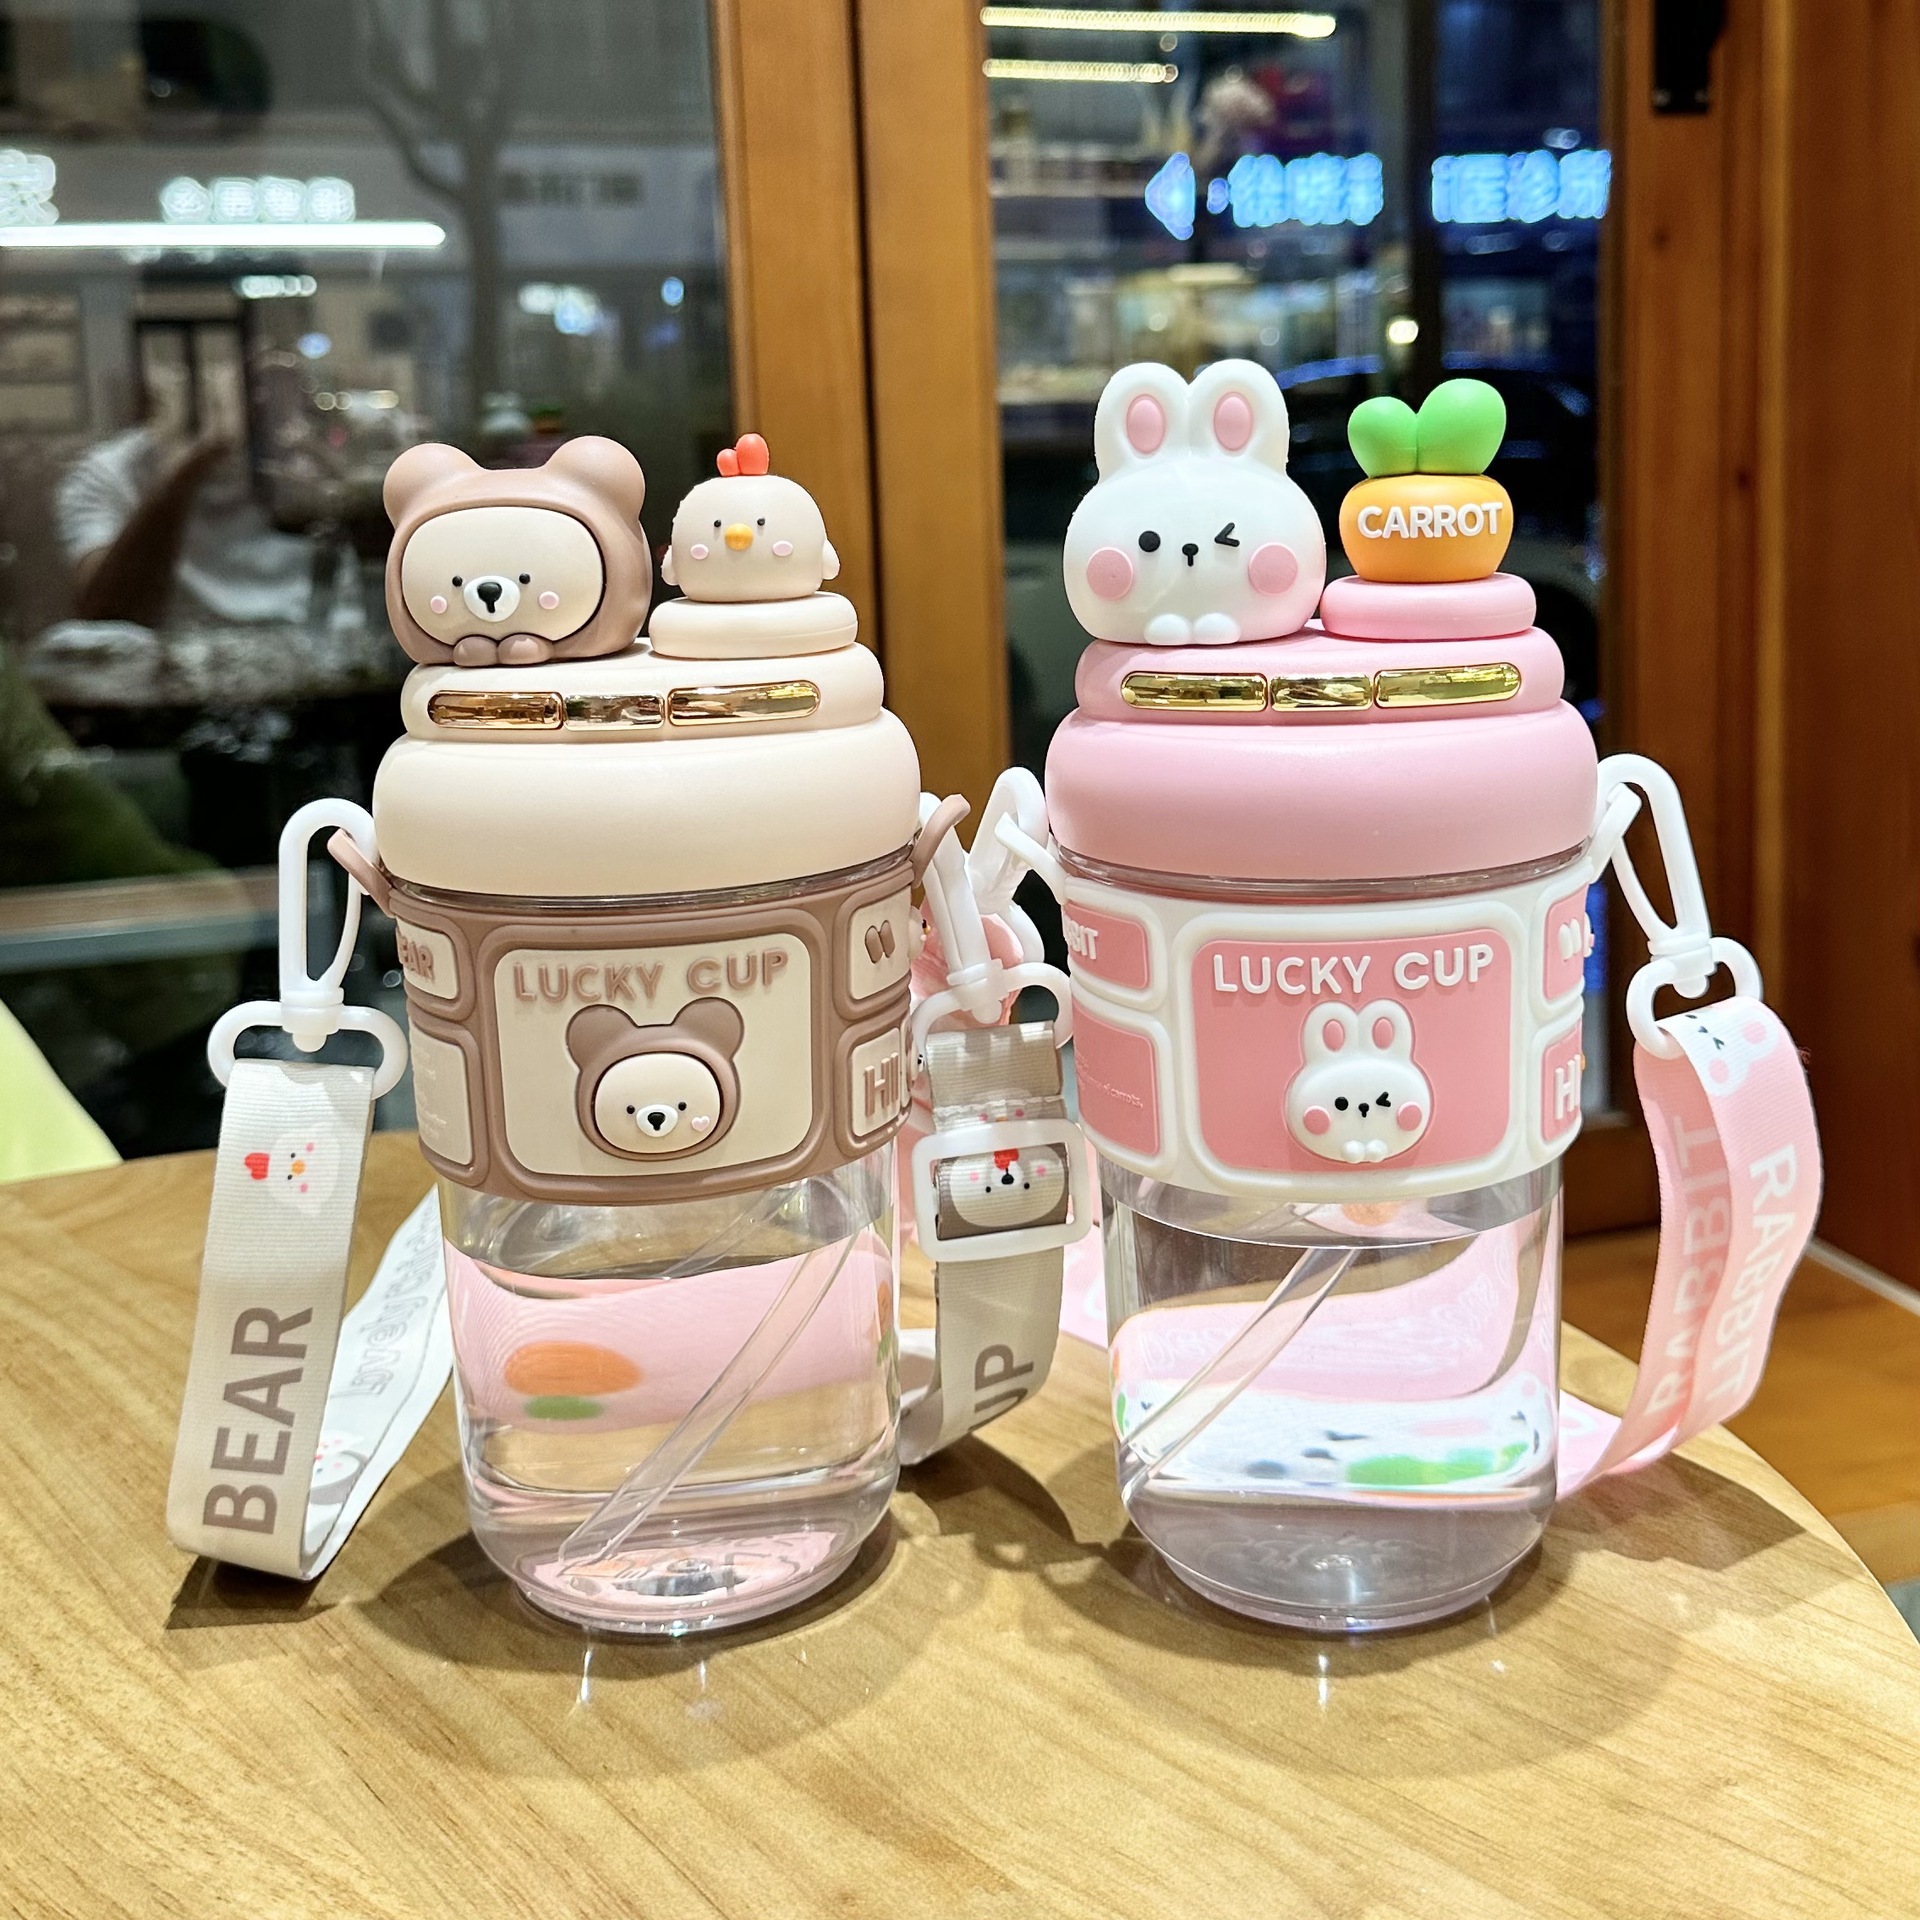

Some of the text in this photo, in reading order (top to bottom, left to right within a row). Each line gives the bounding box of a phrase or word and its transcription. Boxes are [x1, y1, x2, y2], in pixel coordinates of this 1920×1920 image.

[1357, 502, 1503, 539] CARROT
[512, 948, 789, 1004] LUCKY CUP
[1212, 943, 1494, 996] LUCKY CUP
[864, 1052, 899, 1118] HI
[1643, 1114, 1732, 1416] RABBIT
[1705, 1143, 1797, 1402] RABBIT
[202, 1306, 314, 1535] BEAR
